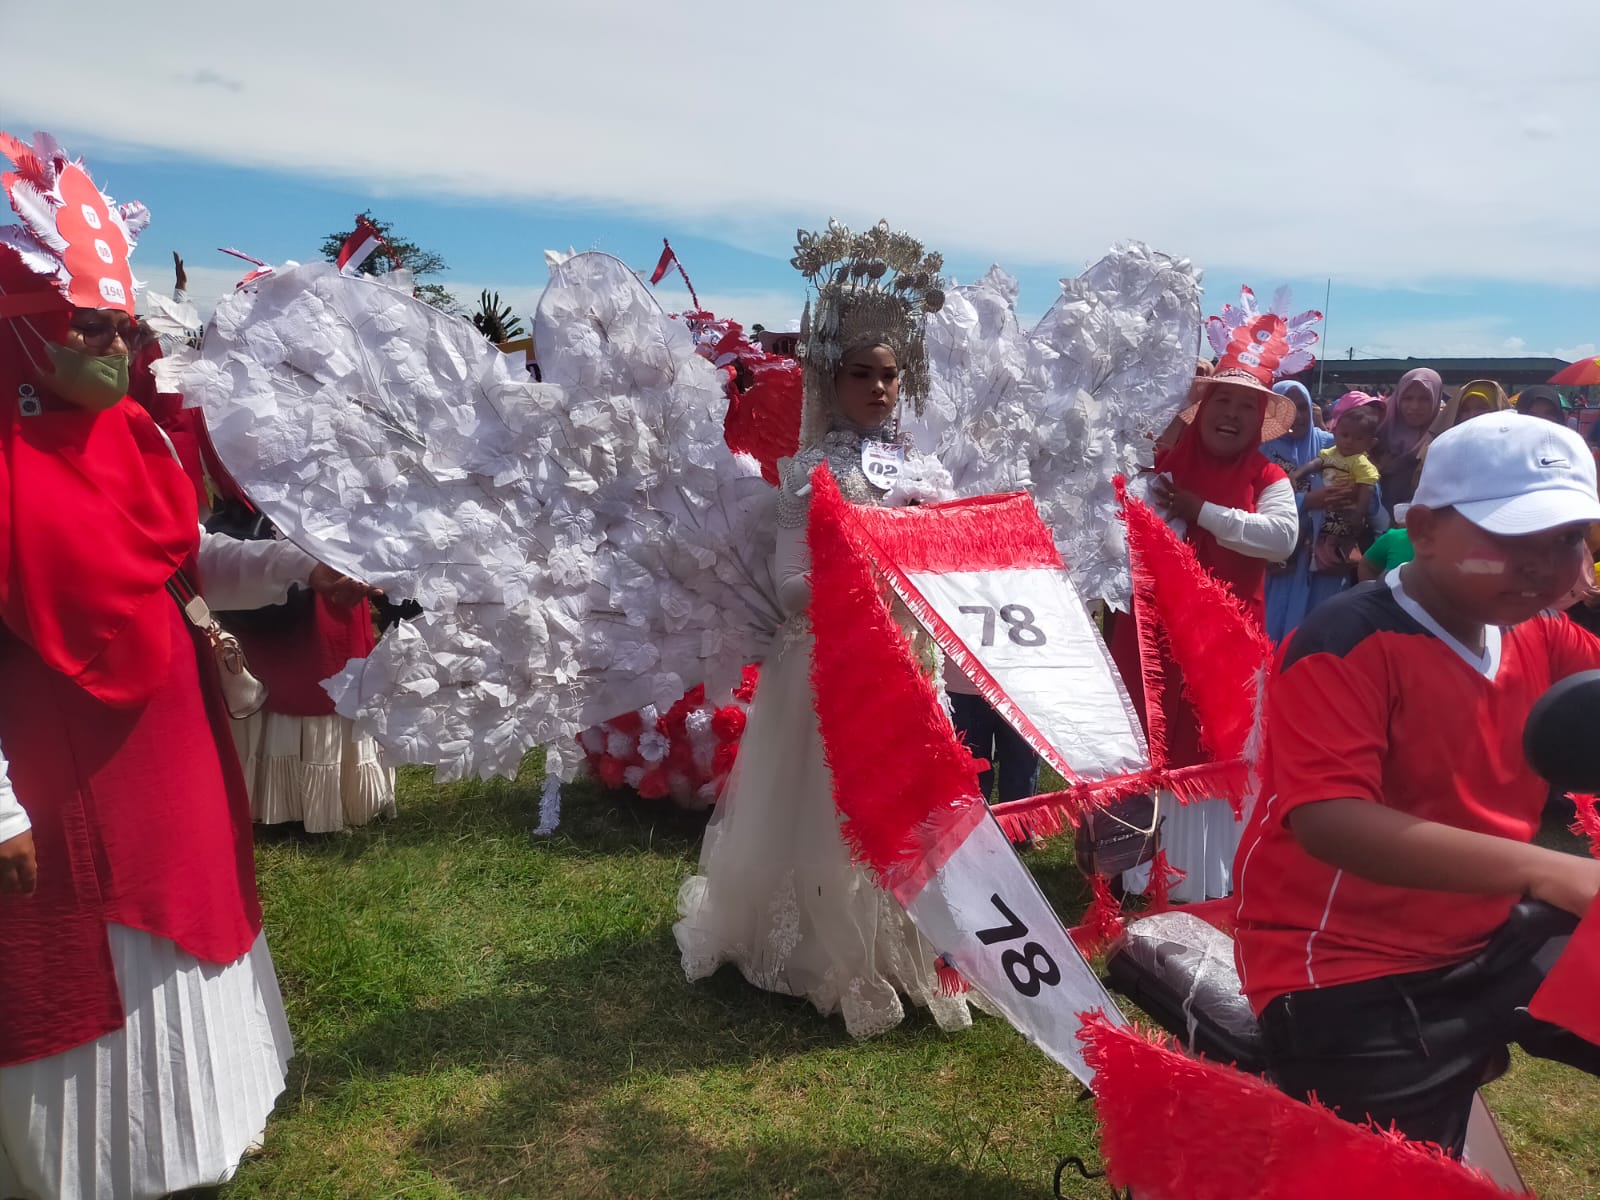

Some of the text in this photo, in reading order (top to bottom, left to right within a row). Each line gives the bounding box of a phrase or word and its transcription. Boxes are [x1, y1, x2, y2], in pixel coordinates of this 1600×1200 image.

[868, 461, 898, 478] 02
[958, 603, 1047, 647] 78
[975, 892, 1061, 997] 78
